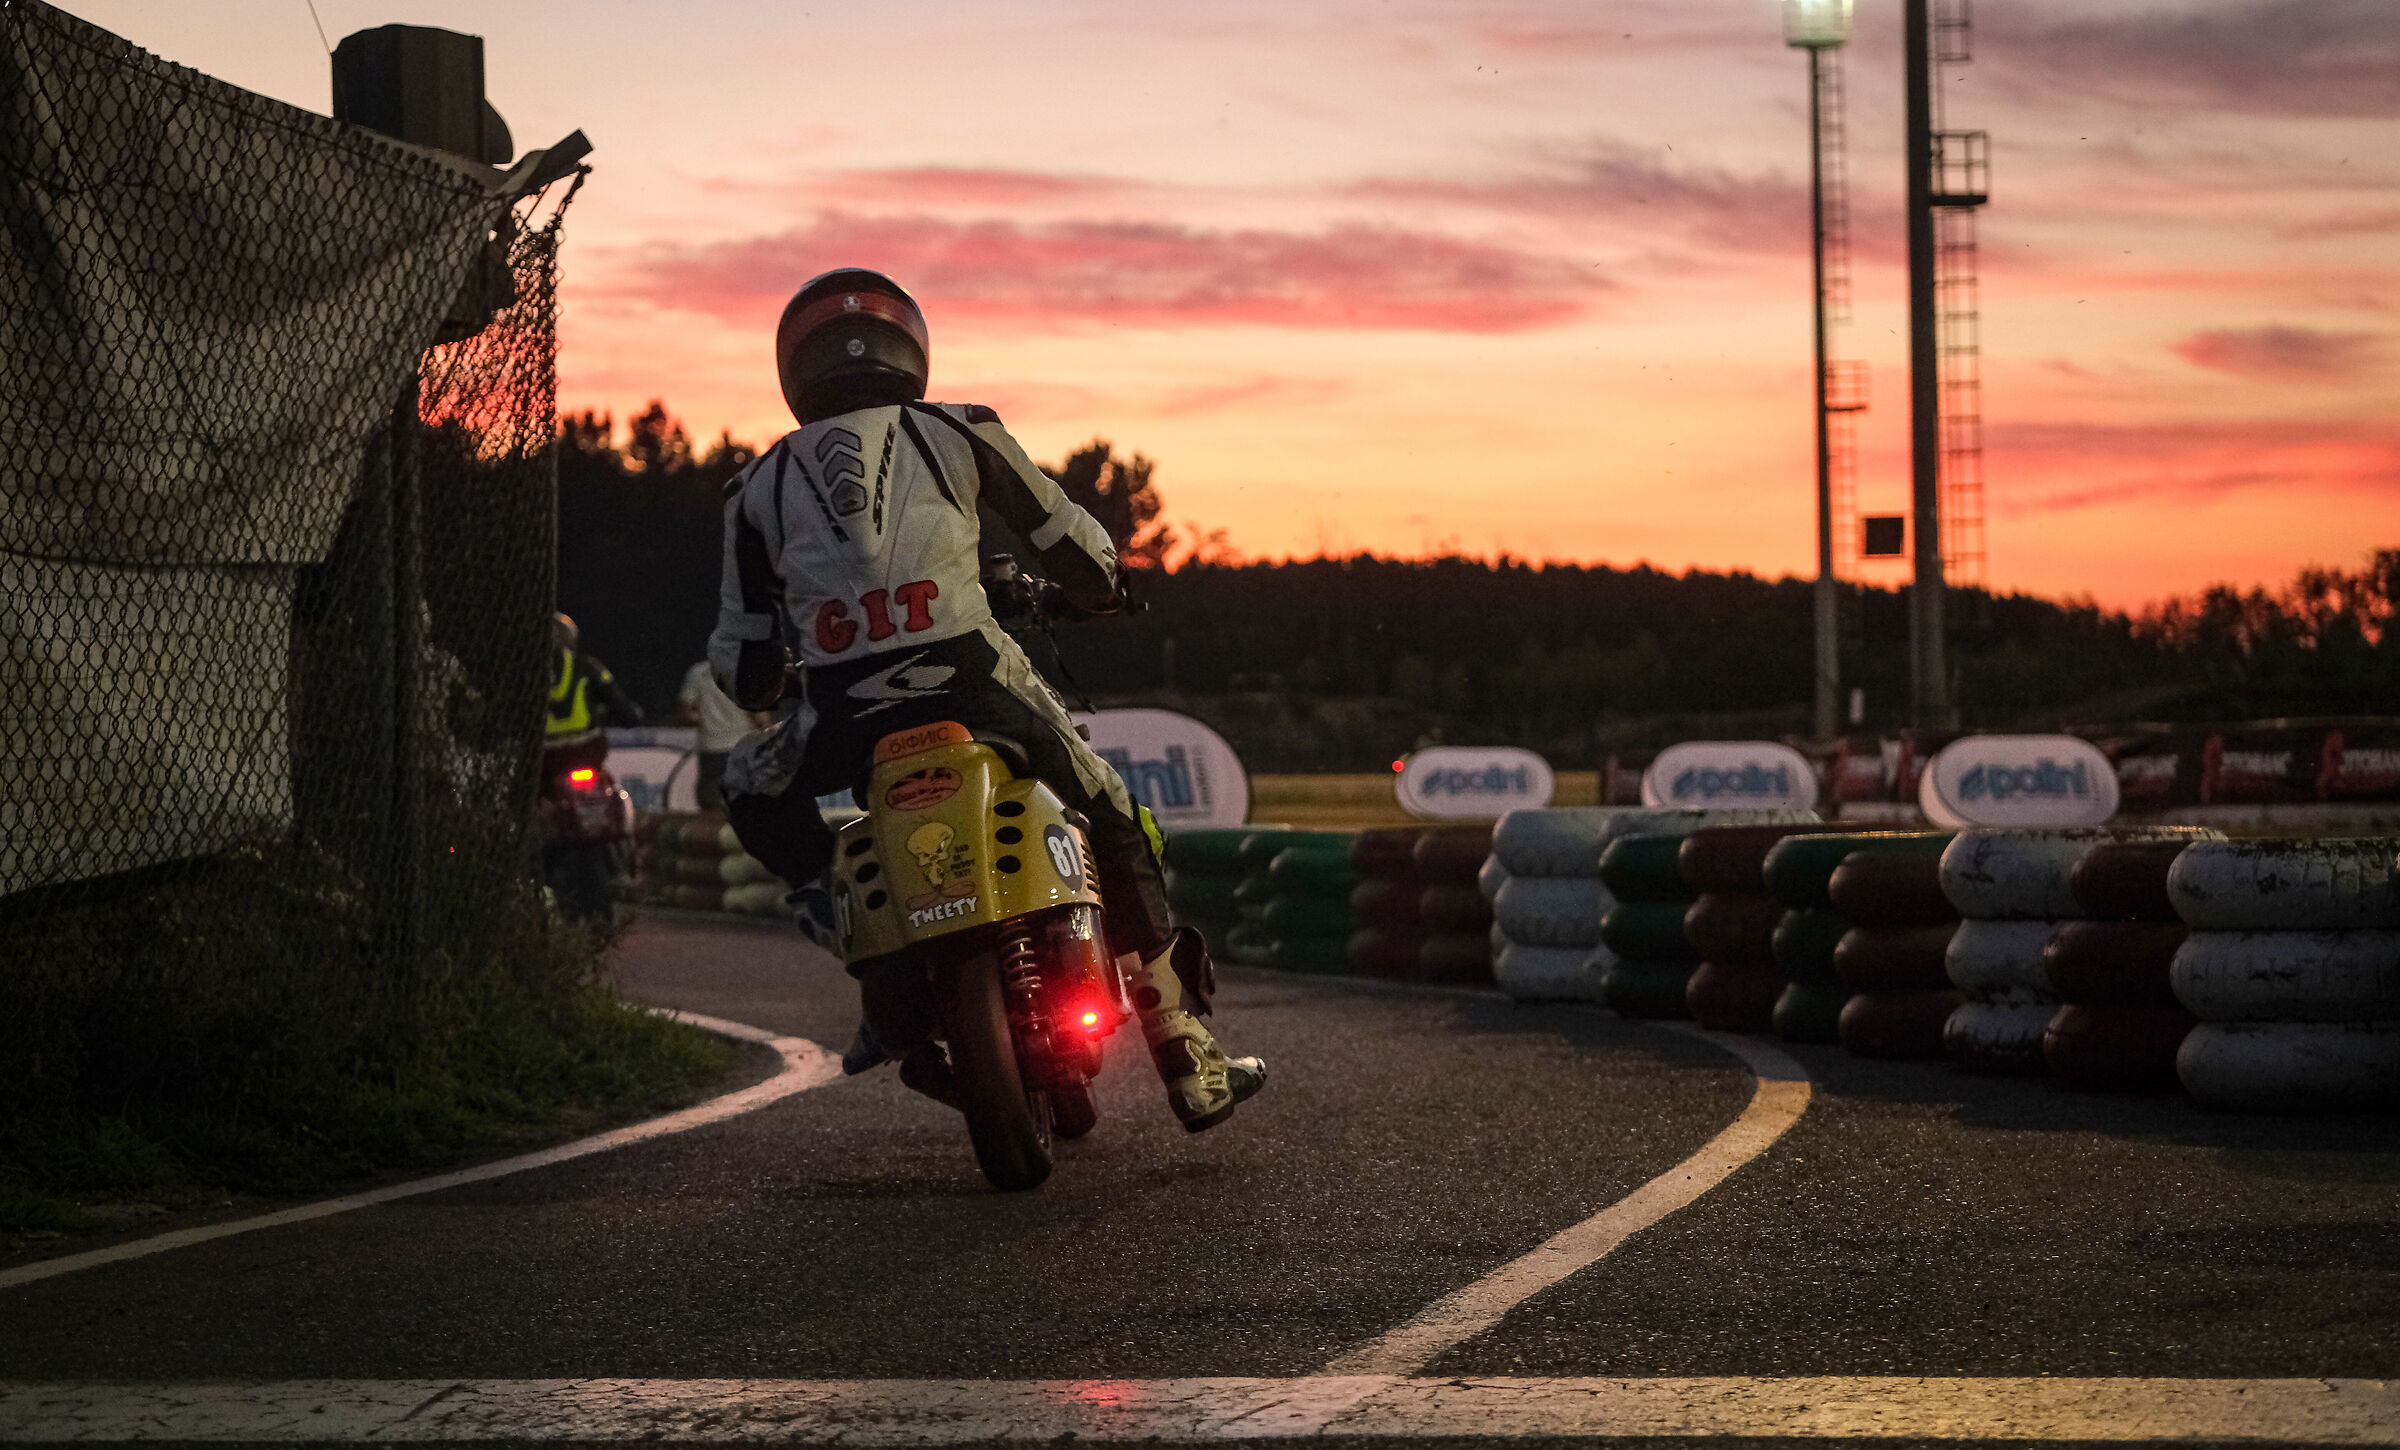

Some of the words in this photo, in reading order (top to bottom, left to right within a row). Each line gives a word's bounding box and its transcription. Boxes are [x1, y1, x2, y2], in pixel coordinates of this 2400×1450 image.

[815, 579, 939, 654] GIT
[1047, 835, 1081, 877] 81
[908, 896, 978, 928] TWEETY
